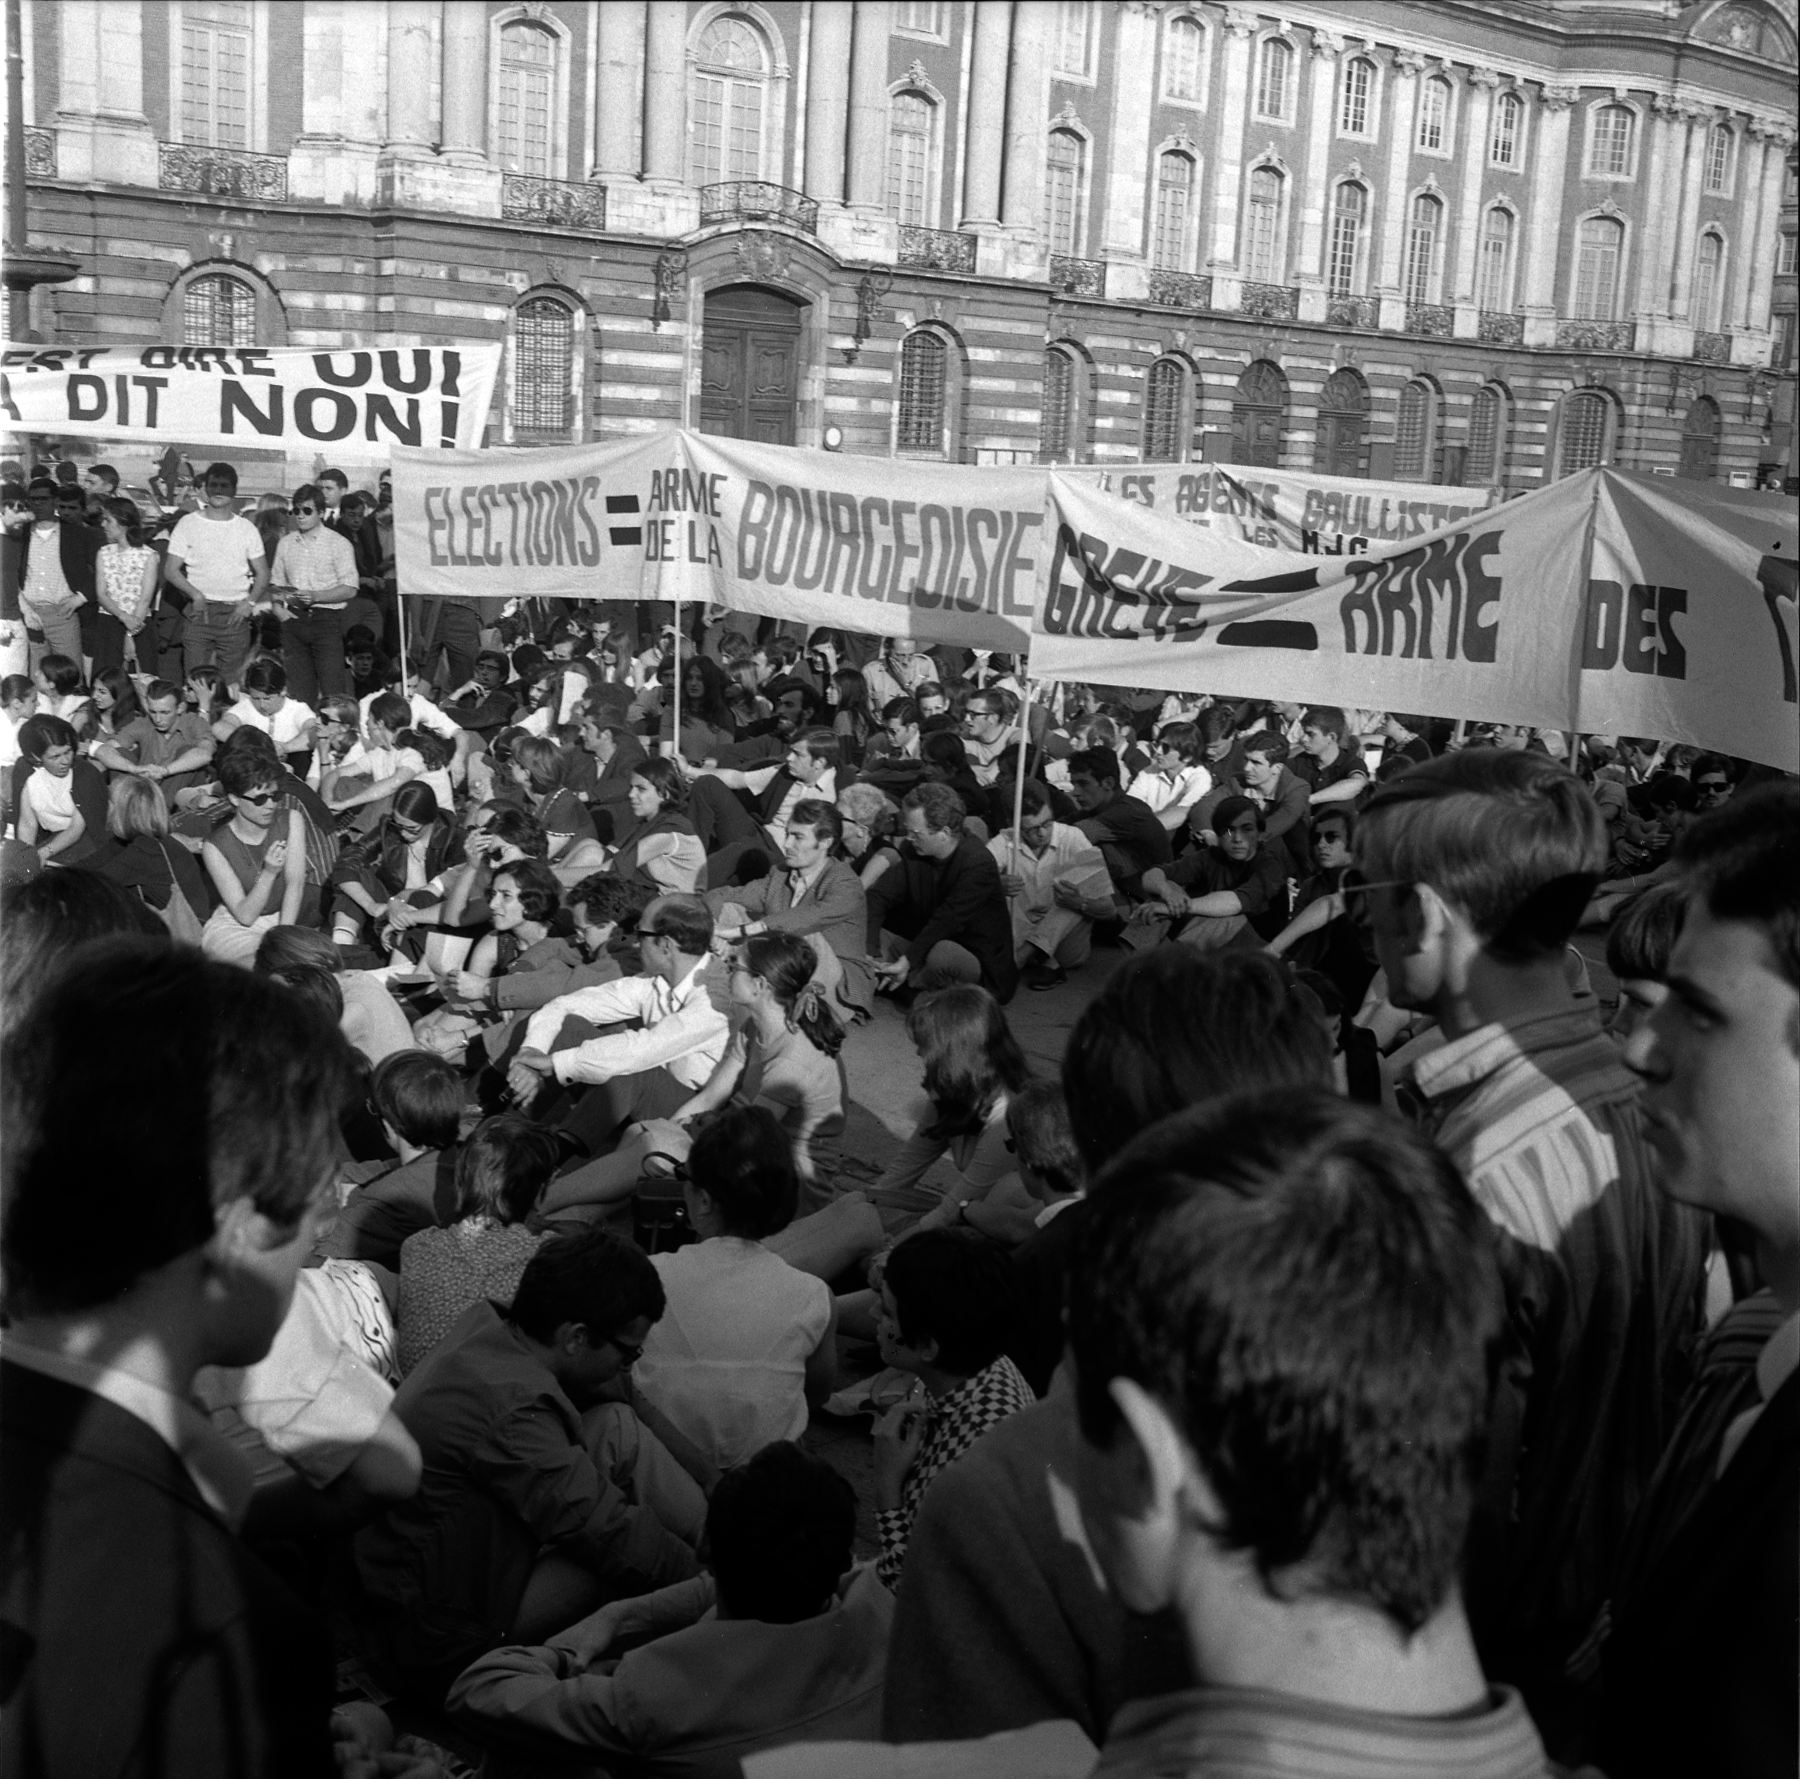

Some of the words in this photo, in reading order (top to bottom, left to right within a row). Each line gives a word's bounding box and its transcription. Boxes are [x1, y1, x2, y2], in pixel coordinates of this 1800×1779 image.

[67, 373, 168, 428] DIT
[220, 378, 460, 448] NON!
[312, 349, 461, 398] OUI
[424, 475, 601, 568] ELECTIONS
[647, 468, 728, 517] ARME
[645, 519, 675, 561] DE
[688, 520, 722, 568] LA
[737, 479, 1045, 617] BOURGEOISIE
[1340, 530, 1505, 663] ARME
[1581, 579, 1688, 680] DES
